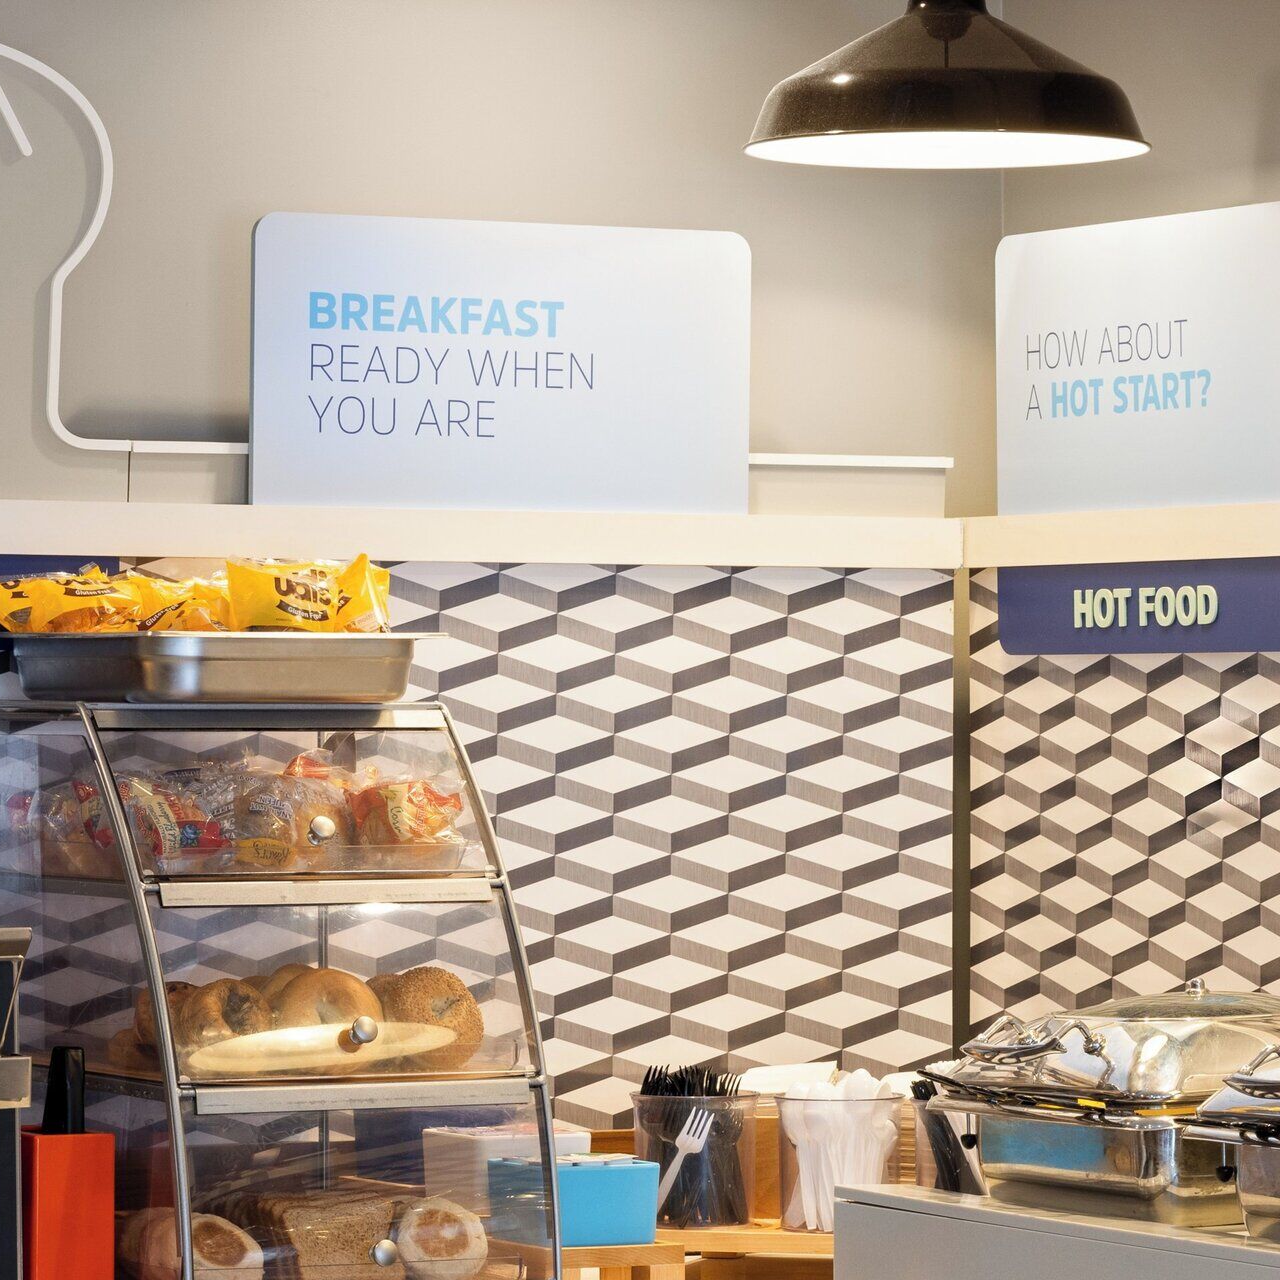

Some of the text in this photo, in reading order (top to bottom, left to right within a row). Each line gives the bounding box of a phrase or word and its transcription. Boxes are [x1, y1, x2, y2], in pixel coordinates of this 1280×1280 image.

[308, 291, 565, 338] BREAKFAST
[310, 344, 594, 390] READY WHEN
[1026, 319, 1188, 371] HOW ABOUT
[308, 395, 496, 438] YOU ARE
[1026, 369, 1212, 420] A HOT START?
[1073, 585, 1219, 629] HOT FOOD
